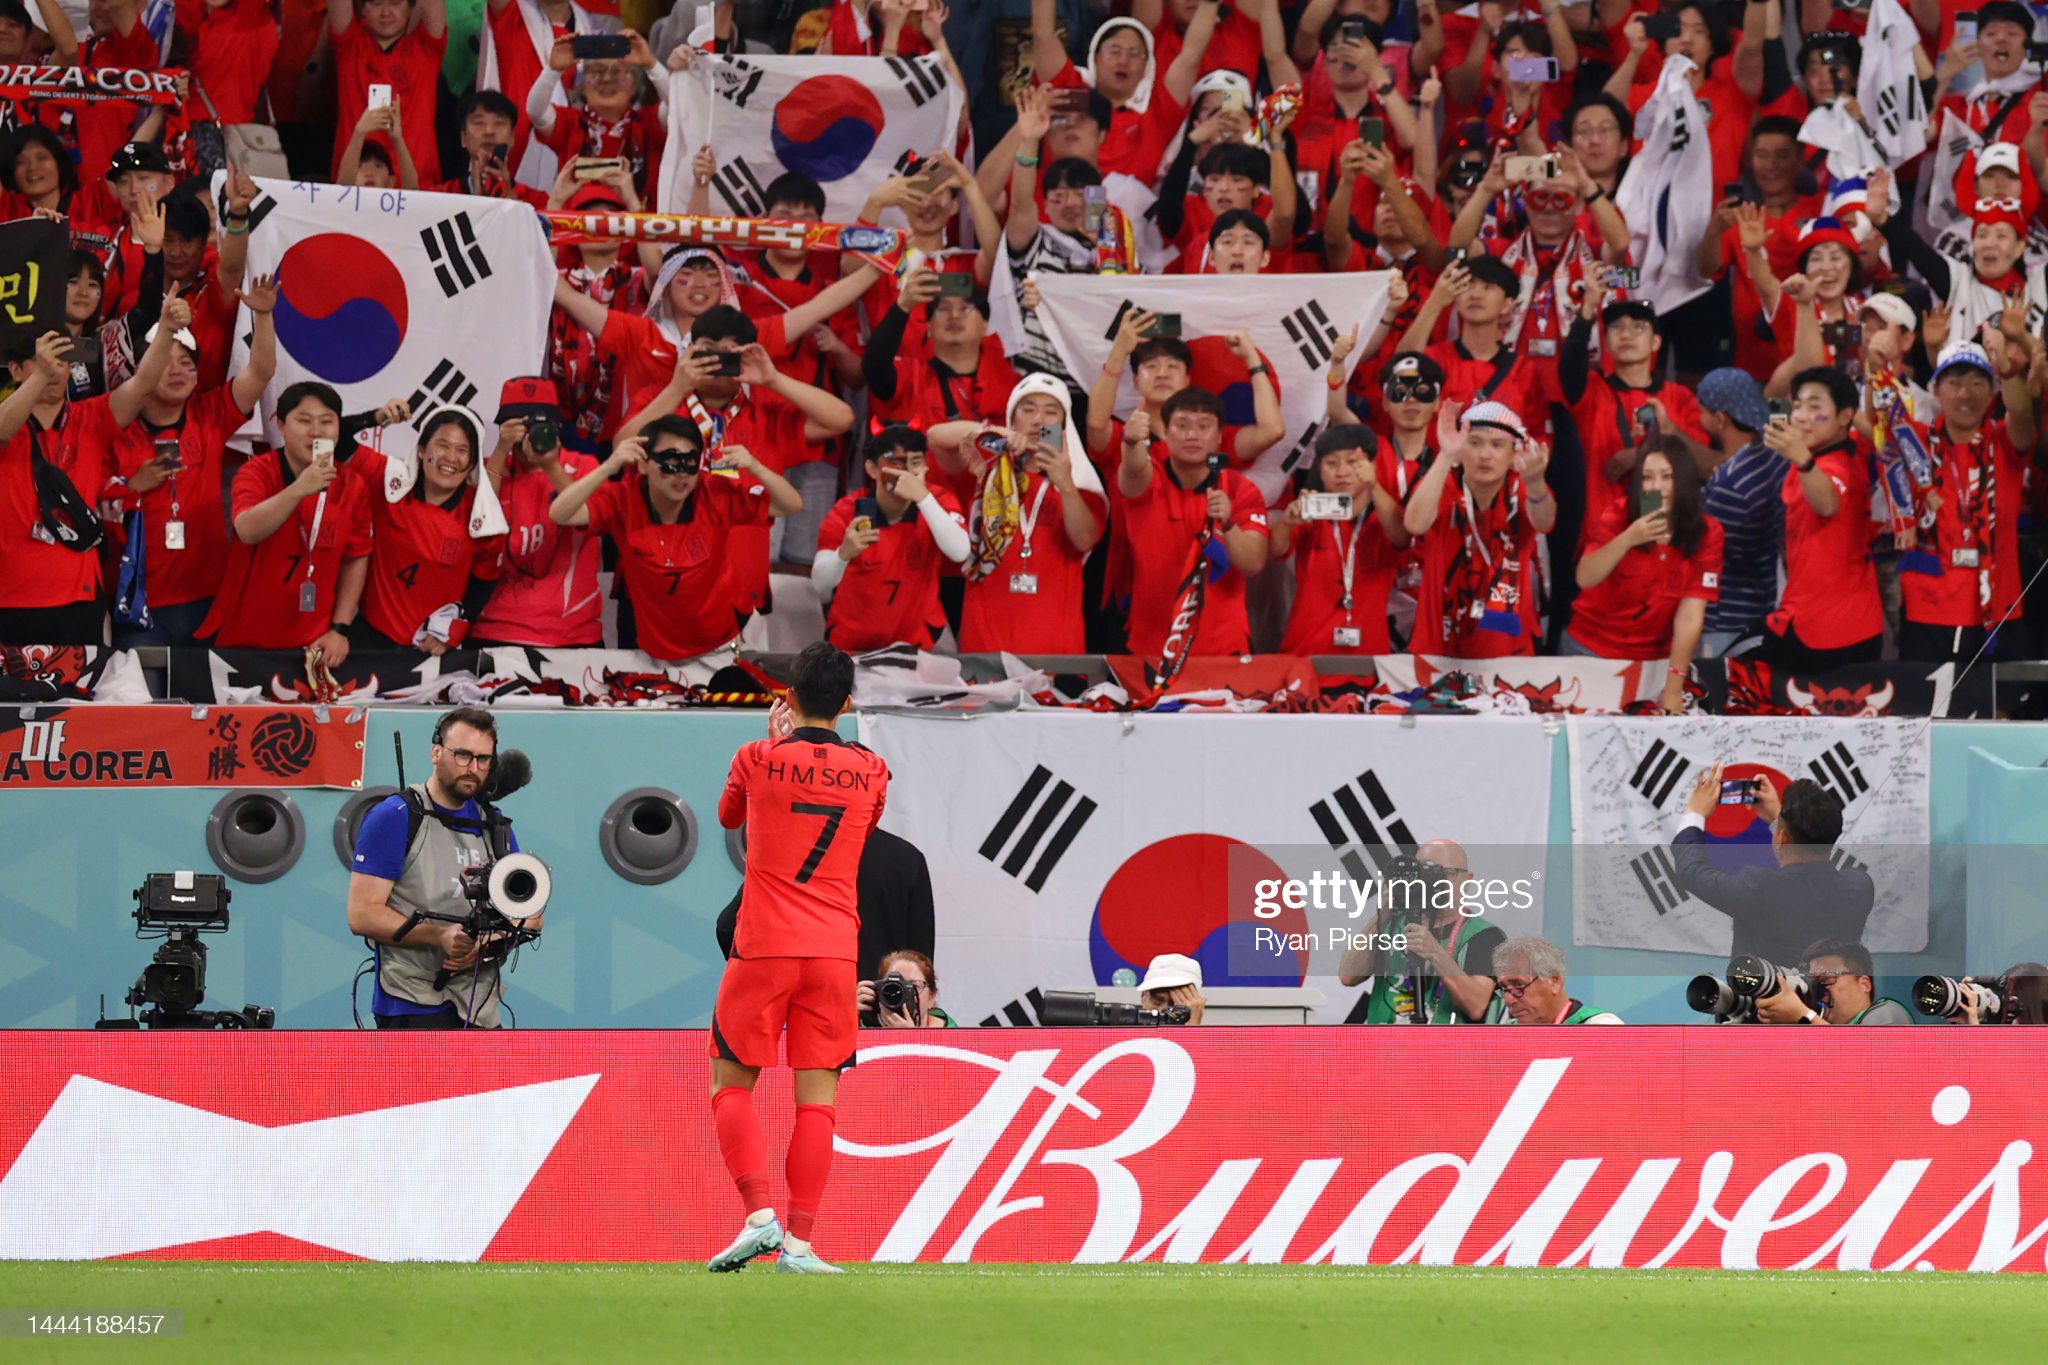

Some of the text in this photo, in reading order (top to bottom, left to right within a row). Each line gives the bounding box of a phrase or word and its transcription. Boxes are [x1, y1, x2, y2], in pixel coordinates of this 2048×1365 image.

[96, 67, 182, 93] COR
[584, 214, 807, 249] 대한민국
[520, 524, 544, 556] 18
[283, 555, 302, 584] 7
[396, 562, 420, 589] 4
[663, 572, 681, 596] 7
[884, 580, 900, 606] 7
[21, 720, 67, 761] 마
[43, 750, 173, 782] COREA
[821, 768, 870, 792] SON
[791, 801, 847, 884] 7
[833, 1038, 2048, 1272] Budweis
